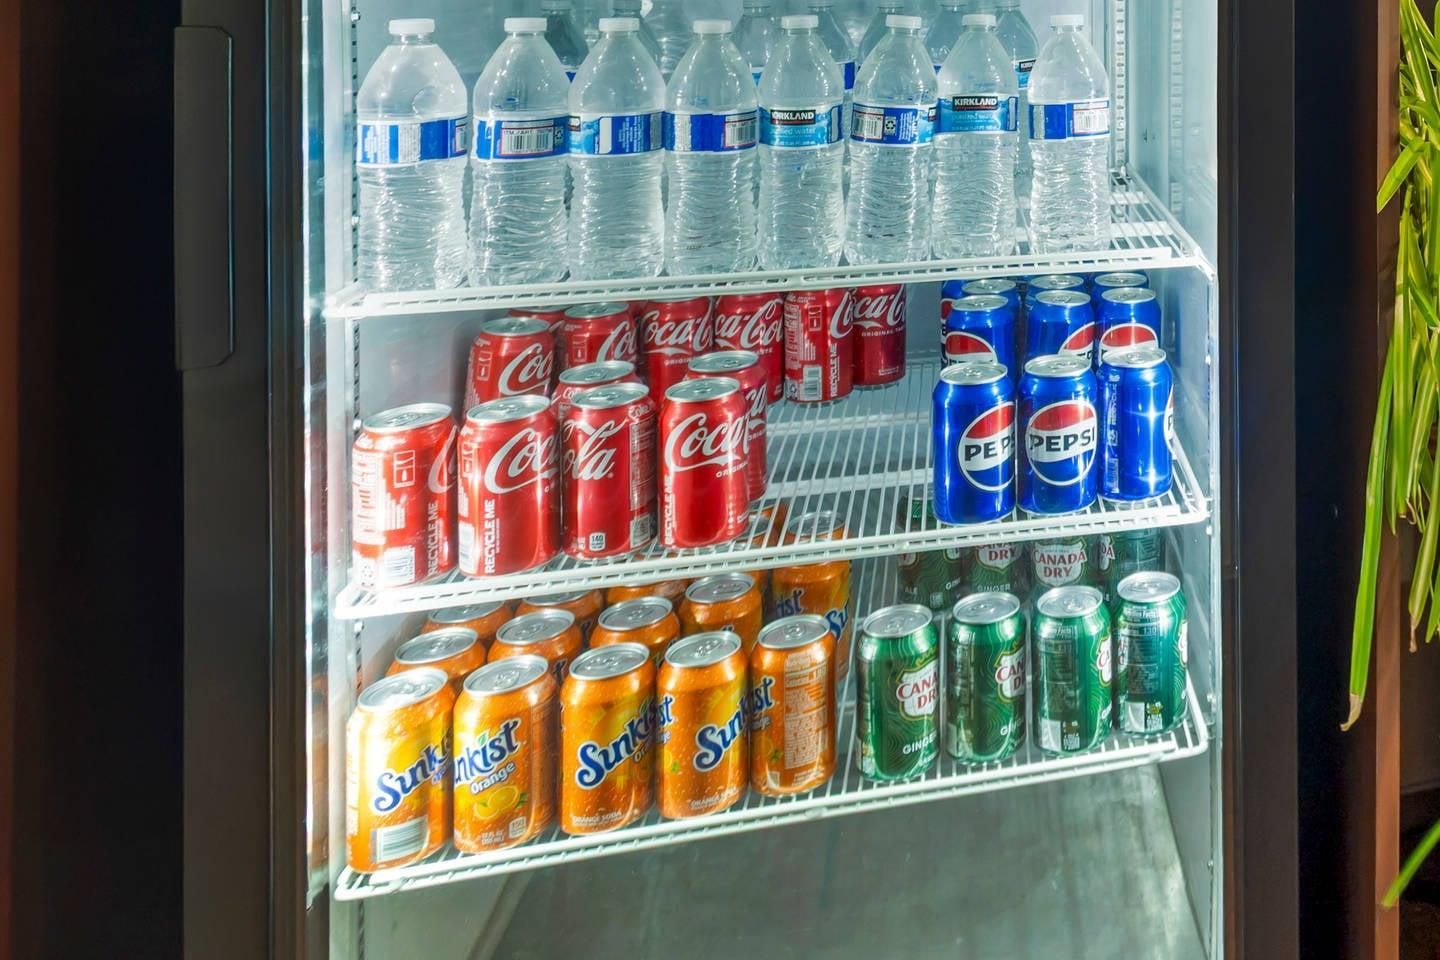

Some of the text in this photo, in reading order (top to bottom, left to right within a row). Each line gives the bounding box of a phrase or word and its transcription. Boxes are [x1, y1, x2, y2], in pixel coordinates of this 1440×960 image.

[954, 97, 997, 107] KIRKLAND
[1030, 426, 1095, 453] PEPSI
[427, 500, 438, 577] RECYCLE ME
[484, 499, 496, 574] RECYCLE ME
[989, 549, 1016, 561] DRY
[1033, 549, 1087, 566] CANADA
[1044, 566, 1072, 577] DRY
[470, 761, 516, 795] Orange
